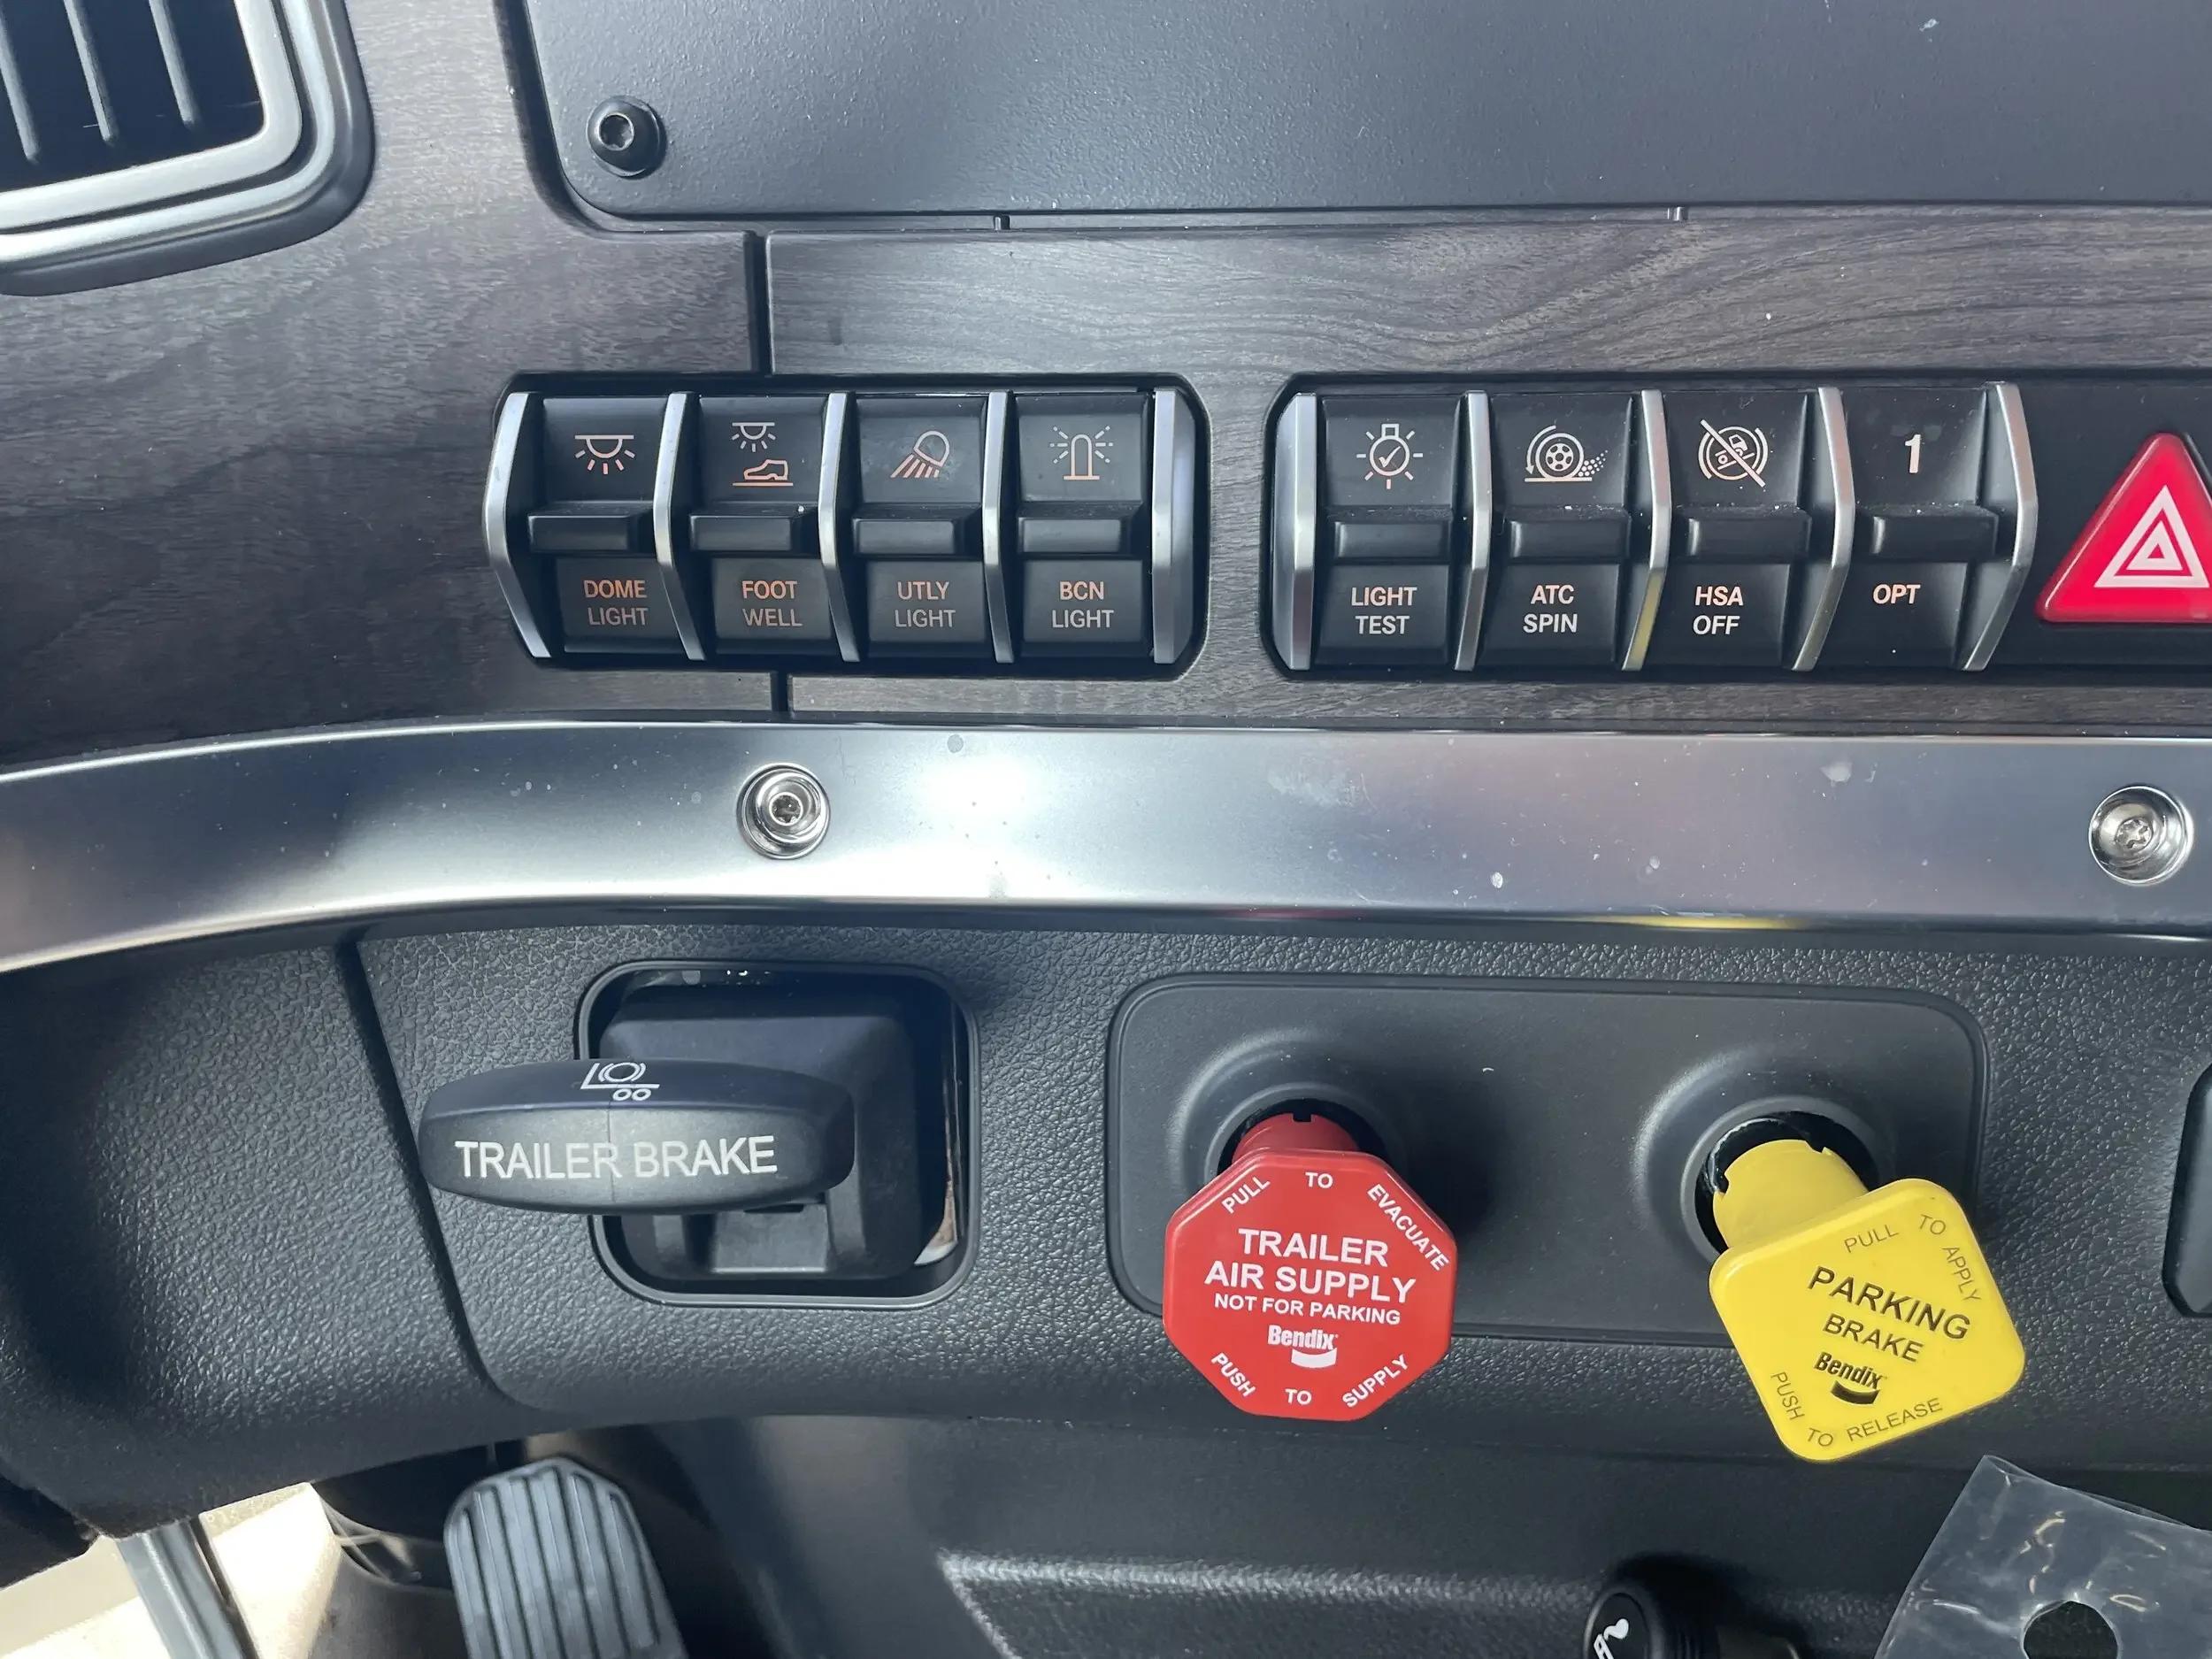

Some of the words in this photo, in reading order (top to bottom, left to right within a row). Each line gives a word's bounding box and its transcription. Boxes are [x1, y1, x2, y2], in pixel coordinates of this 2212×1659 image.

[1902, 434, 1921, 473] 1
[583, 580, 646, 599] DOME
[741, 581, 797, 599] FOOT
[896, 581, 949, 600] UTLY
[1058, 581, 1105, 600] BCN
[1350, 586, 1417, 607] LIGHT
[1530, 585, 1574, 605] ATC
[1694, 586, 1743, 606] HSA
[1871, 584, 1921, 604] OPT
[588, 607, 648, 626] LIGHT
[741, 609, 802, 627] WELL
[894, 609, 956, 627] LIGHT
[1050, 609, 1114, 628] LIGHT
[1355, 614, 1409, 634] TEST
[1522, 612, 1578, 634] SPIN
[1692, 614, 1740, 634] OFF
[454, 1141, 621, 1179] TRAILER
[634, 1136, 778, 1177] BRAKE
[1221, 1175, 1270, 1213] PULL
[1305, 1172, 1333, 1188] TO
[1367, 1184, 1449, 1270] EVACUATE
[1238, 1228, 1388, 1267] TRAILER
[1843, 1224, 1898, 1252] PULL
[1917, 1214, 1946, 1234] TO
[1941, 1246, 1982, 1303] APPLY
[1204, 1261, 1264, 1289] AIR
[1274, 1267, 1416, 1303] SUPPLY
[1214, 1294, 1256, 1310] NOT
[1262, 1298, 1303, 1316] FOR
[1309, 1302, 1401, 1325] PARKING
[1807, 1266, 1970, 1340] PARKING
[1267, 1325, 1334, 1349] Bendix
[1822, 1314, 1924, 1362] BRAKE
[1210, 1353, 1256, 1398] PUSH
[1285, 1389, 1312, 1405] TO
[1341, 1355, 1409, 1408] SUPPLY
[1813, 1352, 1884, 1389] Bendix
[1770, 1371, 1805, 1420] PUSH
[1806, 1428, 1833, 1447] TO
[1847, 1398, 1943, 1442] RELEASE
